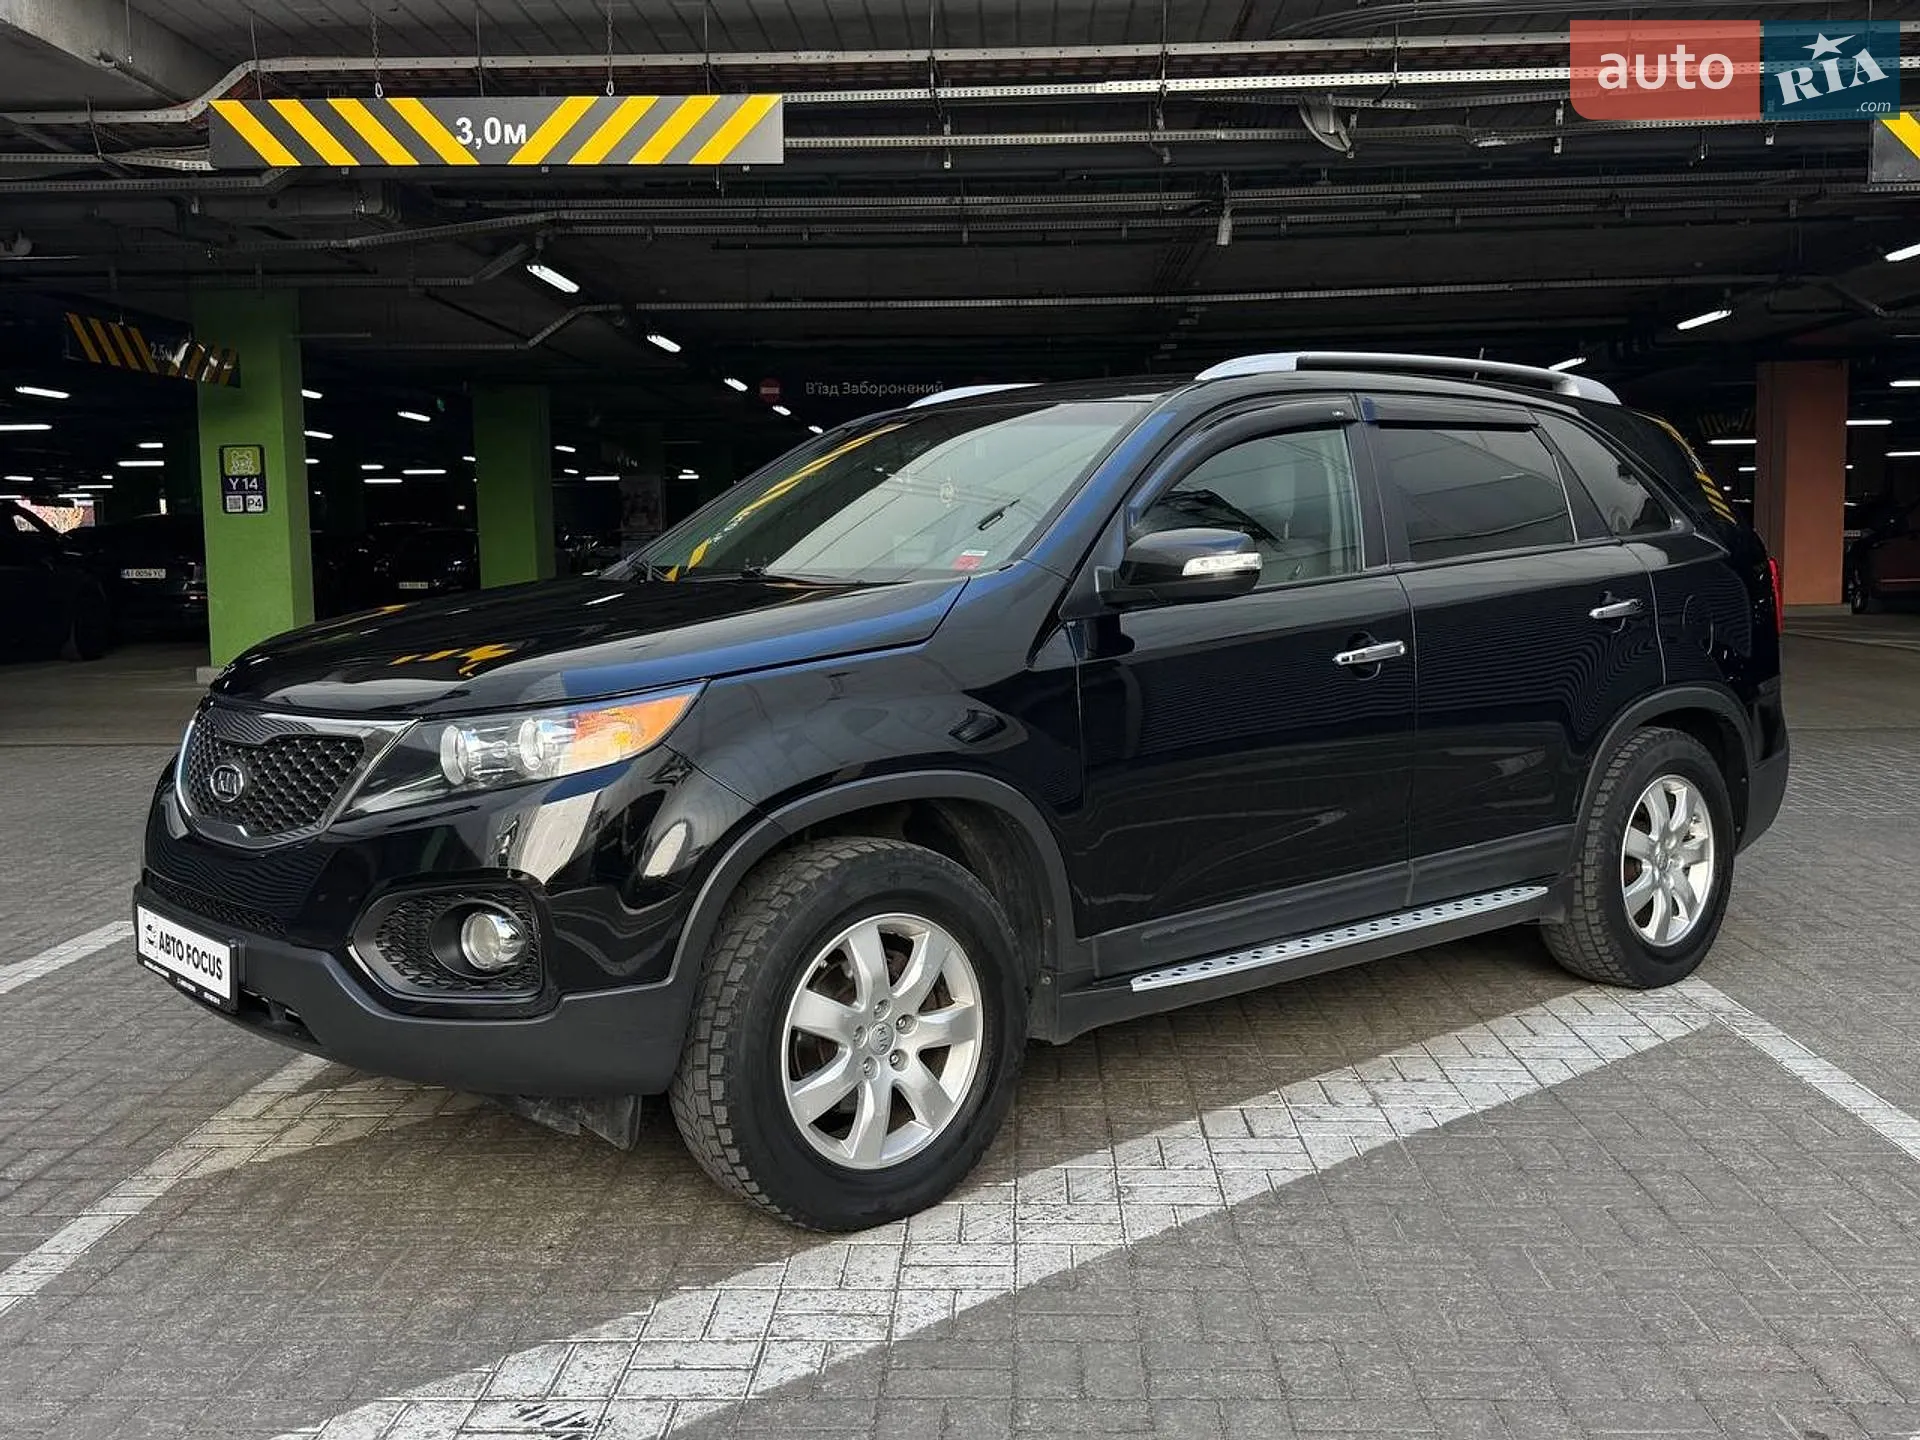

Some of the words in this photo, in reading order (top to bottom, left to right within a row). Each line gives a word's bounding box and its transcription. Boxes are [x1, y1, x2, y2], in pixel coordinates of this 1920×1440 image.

[456, 116, 527, 150] 3,0м
[228, 477, 240, 491] Y
[241, 477, 258, 491] 14
[186, 944, 223, 981] FOCUS
